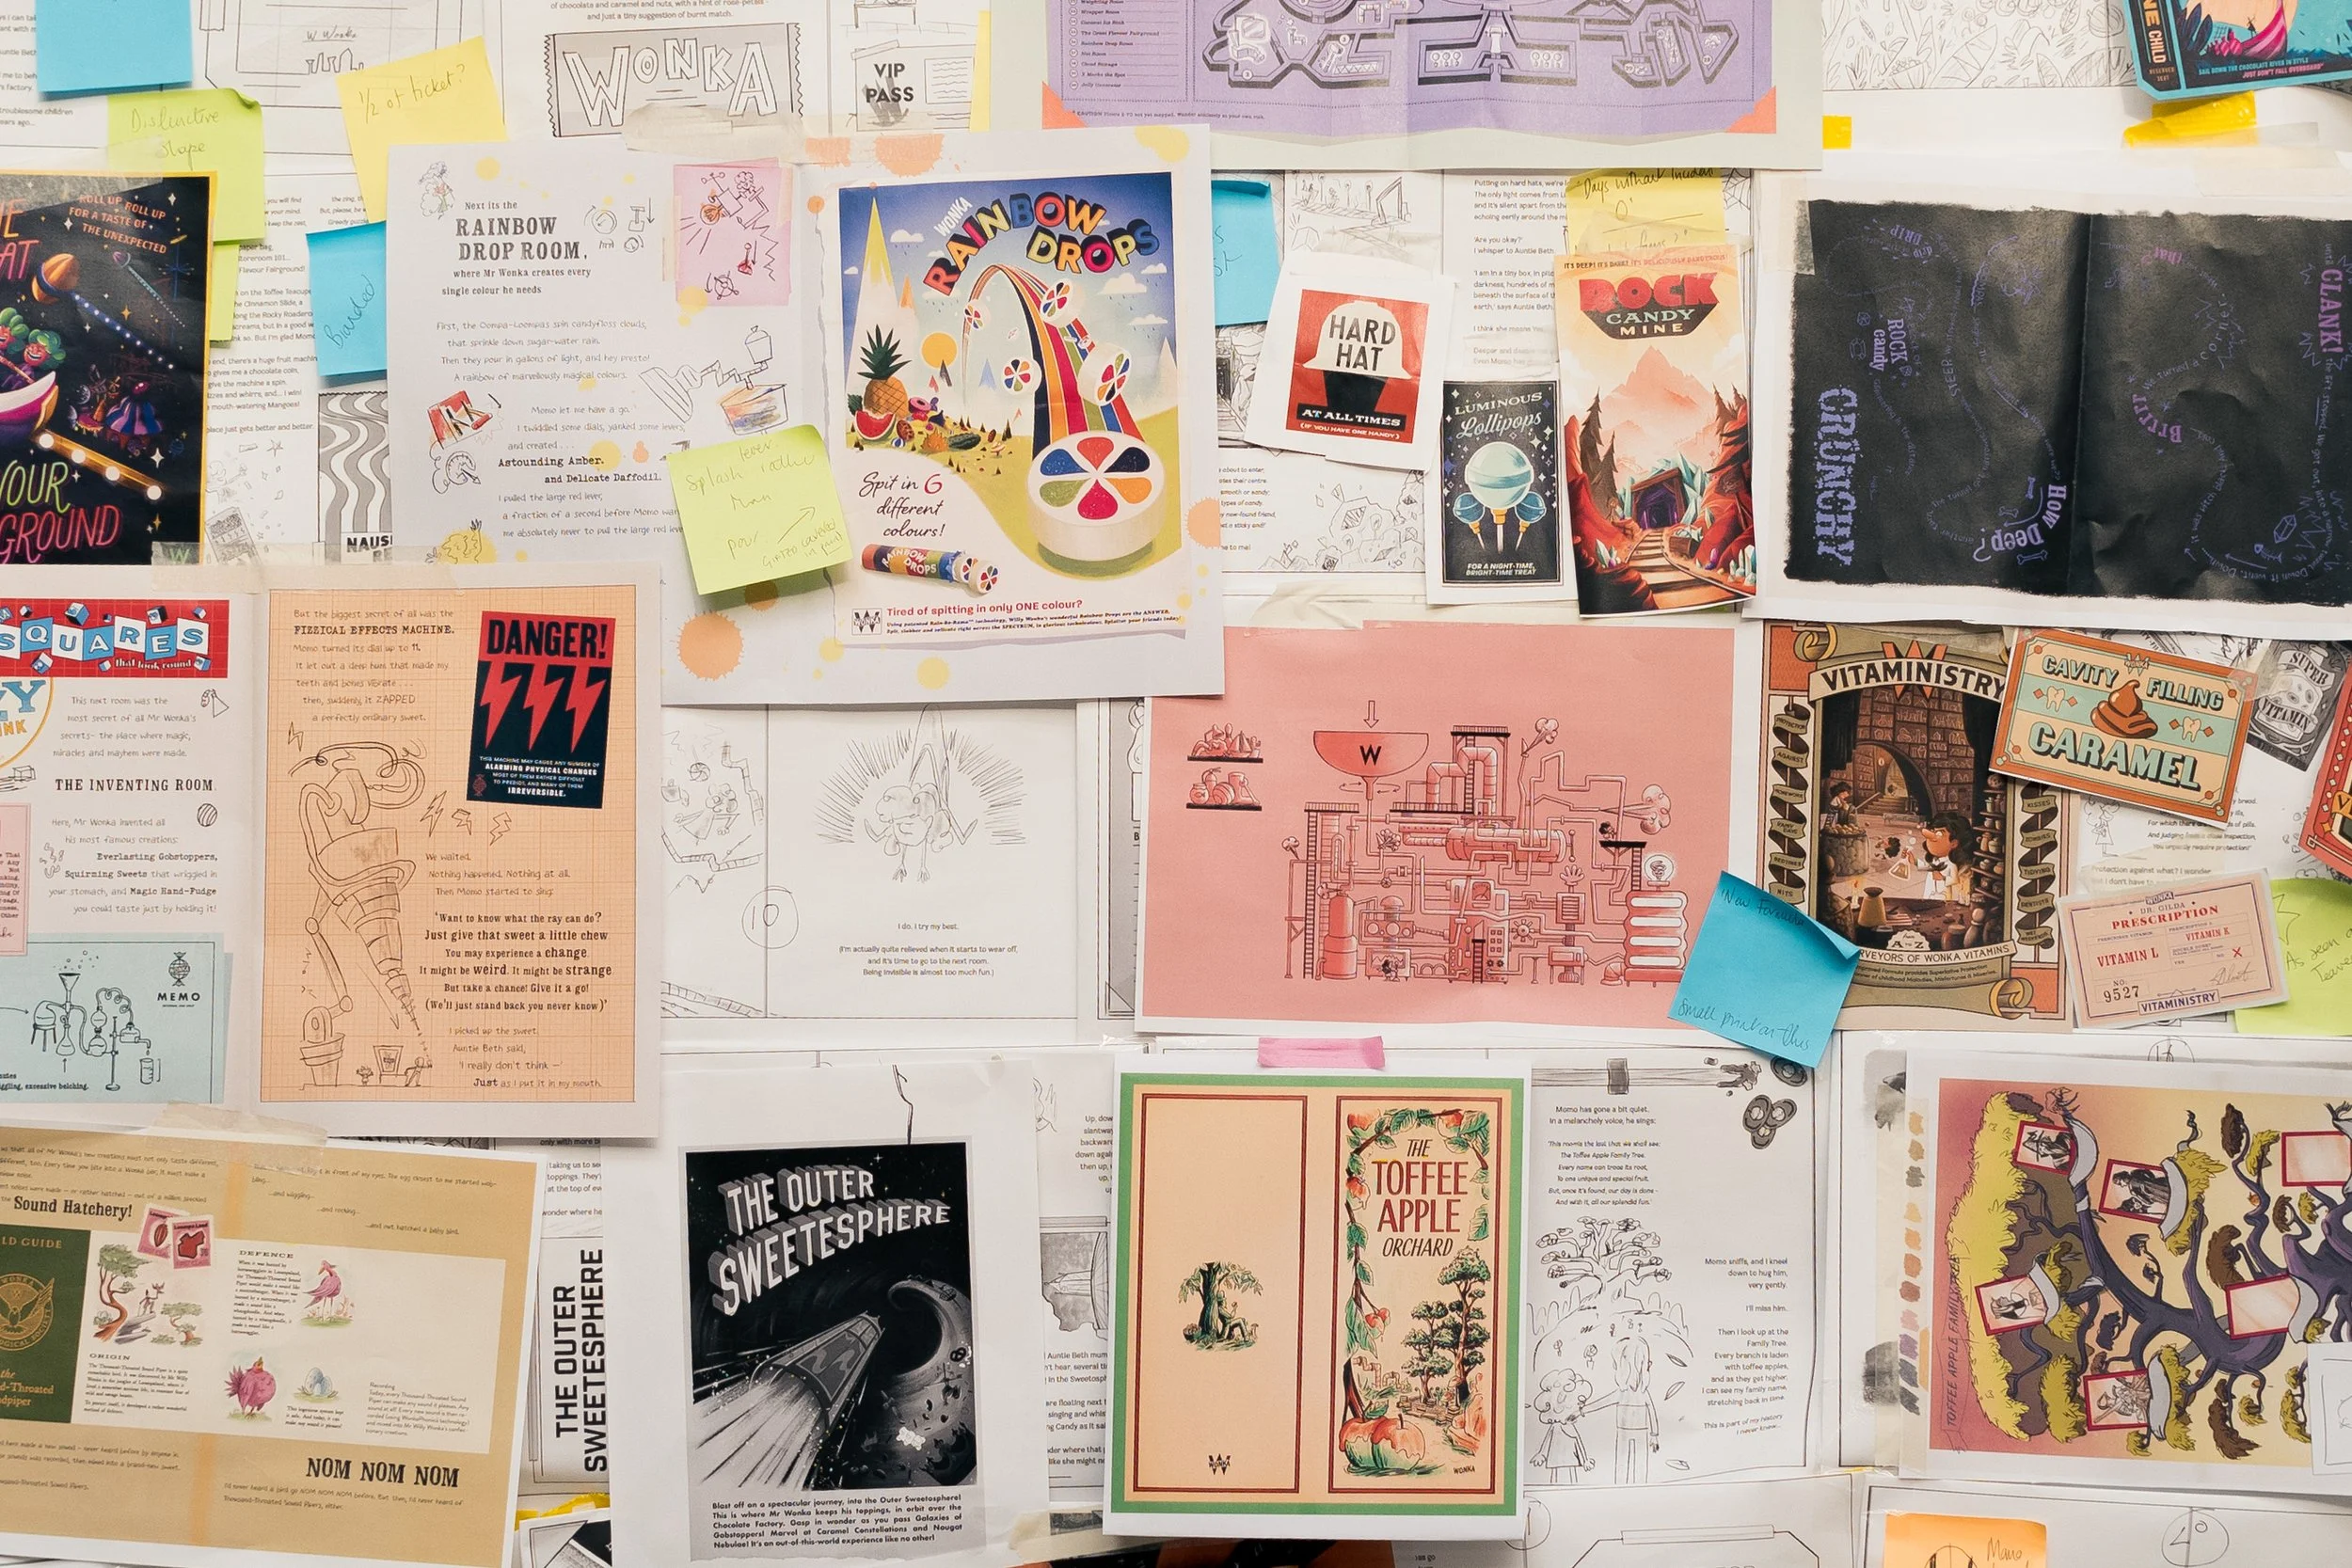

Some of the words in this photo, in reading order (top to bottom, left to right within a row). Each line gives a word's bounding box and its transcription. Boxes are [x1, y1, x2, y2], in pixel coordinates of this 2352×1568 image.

[639, 11, 676, 20] suggestion
[2149, 30, 2167, 63] CHILD
[874, 63, 905, 78] VIP
[563, 38, 777, 127] WONKA
[866, 86, 914, 103] PASS
[80, 195, 105, 203] ROLL
[107, 196, 122, 204] UP
[125, 203, 149, 216] ROLL
[151, 209, 166, 219] UP
[933, 196, 973, 236] WONKA
[70, 207, 88, 218] FOR
[102, 214, 132, 227] TASTE
[135, 220, 147, 229] OF
[455, 217, 557, 236] RAINBOW
[83, 223, 101, 235] THE
[103, 229, 167, 254] UNEXPECTED
[923, 191, 1106, 296] RAINBOW
[1026, 218, 1159, 274] DROPS
[459, 243, 515, 261] DROP
[484, 269, 496, 277] Mr
[499, 269, 528, 277] Wonka
[532, 268, 564, 277] creates
[568, 268, 591, 277] every
[1580, 273, 1720, 313] ROCK
[1606, 309, 1695, 325] CANDY
[2318, 269, 2344, 354] CLANK!
[1329, 314, 1395, 345] HARD
[1621, 324, 1683, 336] MINE
[1869, 329, 1885, 372] candy
[1888, 318, 1908, 363] ROCK
[1336, 343, 1383, 371] HAT
[1454, 392, 1542, 415] LUMINOUS
[1302, 409, 1322, 418] AT
[1324, 412, 1353, 421] ALL
[1356, 415, 1401, 426] TIMES
[1456, 412, 1542, 438] Lollipops
[499, 457, 564, 467] Astounding
[566, 474, 610, 483] Delicate
[859, 471, 898, 498] Spit
[901, 476, 918, 490] in
[1815, 388, 1860, 565] CRUNCHY
[877, 497, 943, 518] different
[883, 519, 946, 537] colours!
[882, 548, 927, 567] RAINBOW
[903, 558, 936, 574] DROPS
[886, 607, 914, 617] Tired
[917, 606, 928, 615] of
[931, 605, 974, 616] spitting
[977, 604, 986, 612] in
[990, 603, 1012, 614] only
[1015, 601, 1039, 611] ONE
[1041, 599, 1083, 610] colour?
[0, 625, 203, 654] SQUARES
[294, 626, 346, 635] FIZZICAL
[350, 626, 397, 634] EFFECTS
[487, 619, 608, 659] DANGER!
[2291, 652, 2329, 686] SUPER
[1821, 660, 2006, 700] VITAMINISTRY
[2042, 655, 2119, 688] CAVITY
[2147, 678, 2223, 711] FILLING
[2261, 696, 2312, 732] VITAMIN
[1359, 745, 1382, 766] W
[2029, 721, 2201, 791] CARAMEL
[485, 763, 522, 771] ALARMING
[56, 779, 83, 791] THE
[89, 779, 168, 791] INVENTING
[2027, 800, 2051, 808] KISSES
[97, 852, 155, 863] Everlasting
[65, 870, 113, 879] Squirming
[130, 887, 157, 895] Magic
[161, 887, 216, 895] Hand-Fudge
[2159, 902, 2185, 911] GILDA
[2112, 906, 2219, 930] PRESCRIPTION
[424, 930, 447, 940] Just
[452, 930, 473, 942] give
[478, 930, 500, 940] that
[504, 930, 534, 940] sweet
[539, 931, 545, 940] a
[549, 930, 577, 940] little
[580, 930, 608, 940] chew
[2185, 928, 2222, 941] VITAMIN
[1908, 954, 1920, 962] OF
[1925, 949, 1961, 962] WONKA
[1964, 945, 2010, 958] VITAMINS
[2097, 950, 2147, 968] VITAMIN
[2151, 947, 2159, 958] L
[157, 992, 200, 1002] MEMO
[2104, 986, 2139, 1004] 9527
[2140, 992, 2217, 1013] VITAMINISTRY
[1407, 1139, 1433, 1157] THE
[1372, 1160, 1469, 1196] TOFFEE
[14, 1196, 57, 1212] Sound
[63, 1200, 133, 1221] Hatchery!
[720, 1174, 778, 1236] THE
[779, 1165, 874, 1212] OUTER
[1377, 1198, 1460, 1232] APPLE
[22, 1238, 62, 1249] GUIDE
[1383, 1238, 1453, 1257] ORCHARD
[239, 1250, 294, 1259] DEFENCE
[708, 1199, 951, 1316] SWEETESPHERE
[553, 1285, 577, 1375] OUTER
[580, 1249, 607, 1471] SWEETESPHERE
[1948, 1338, 1959, 1378] APPLE
[555, 1385, 578, 1437] THE
[1947, 1380, 1958, 1426] TOFFEE
[306, 1458, 352, 1481] NOM
[360, 1462, 406, 1483] NOM
[414, 1465, 460, 1487] NOM
[1453, 1465, 1475, 1475] WONKA
